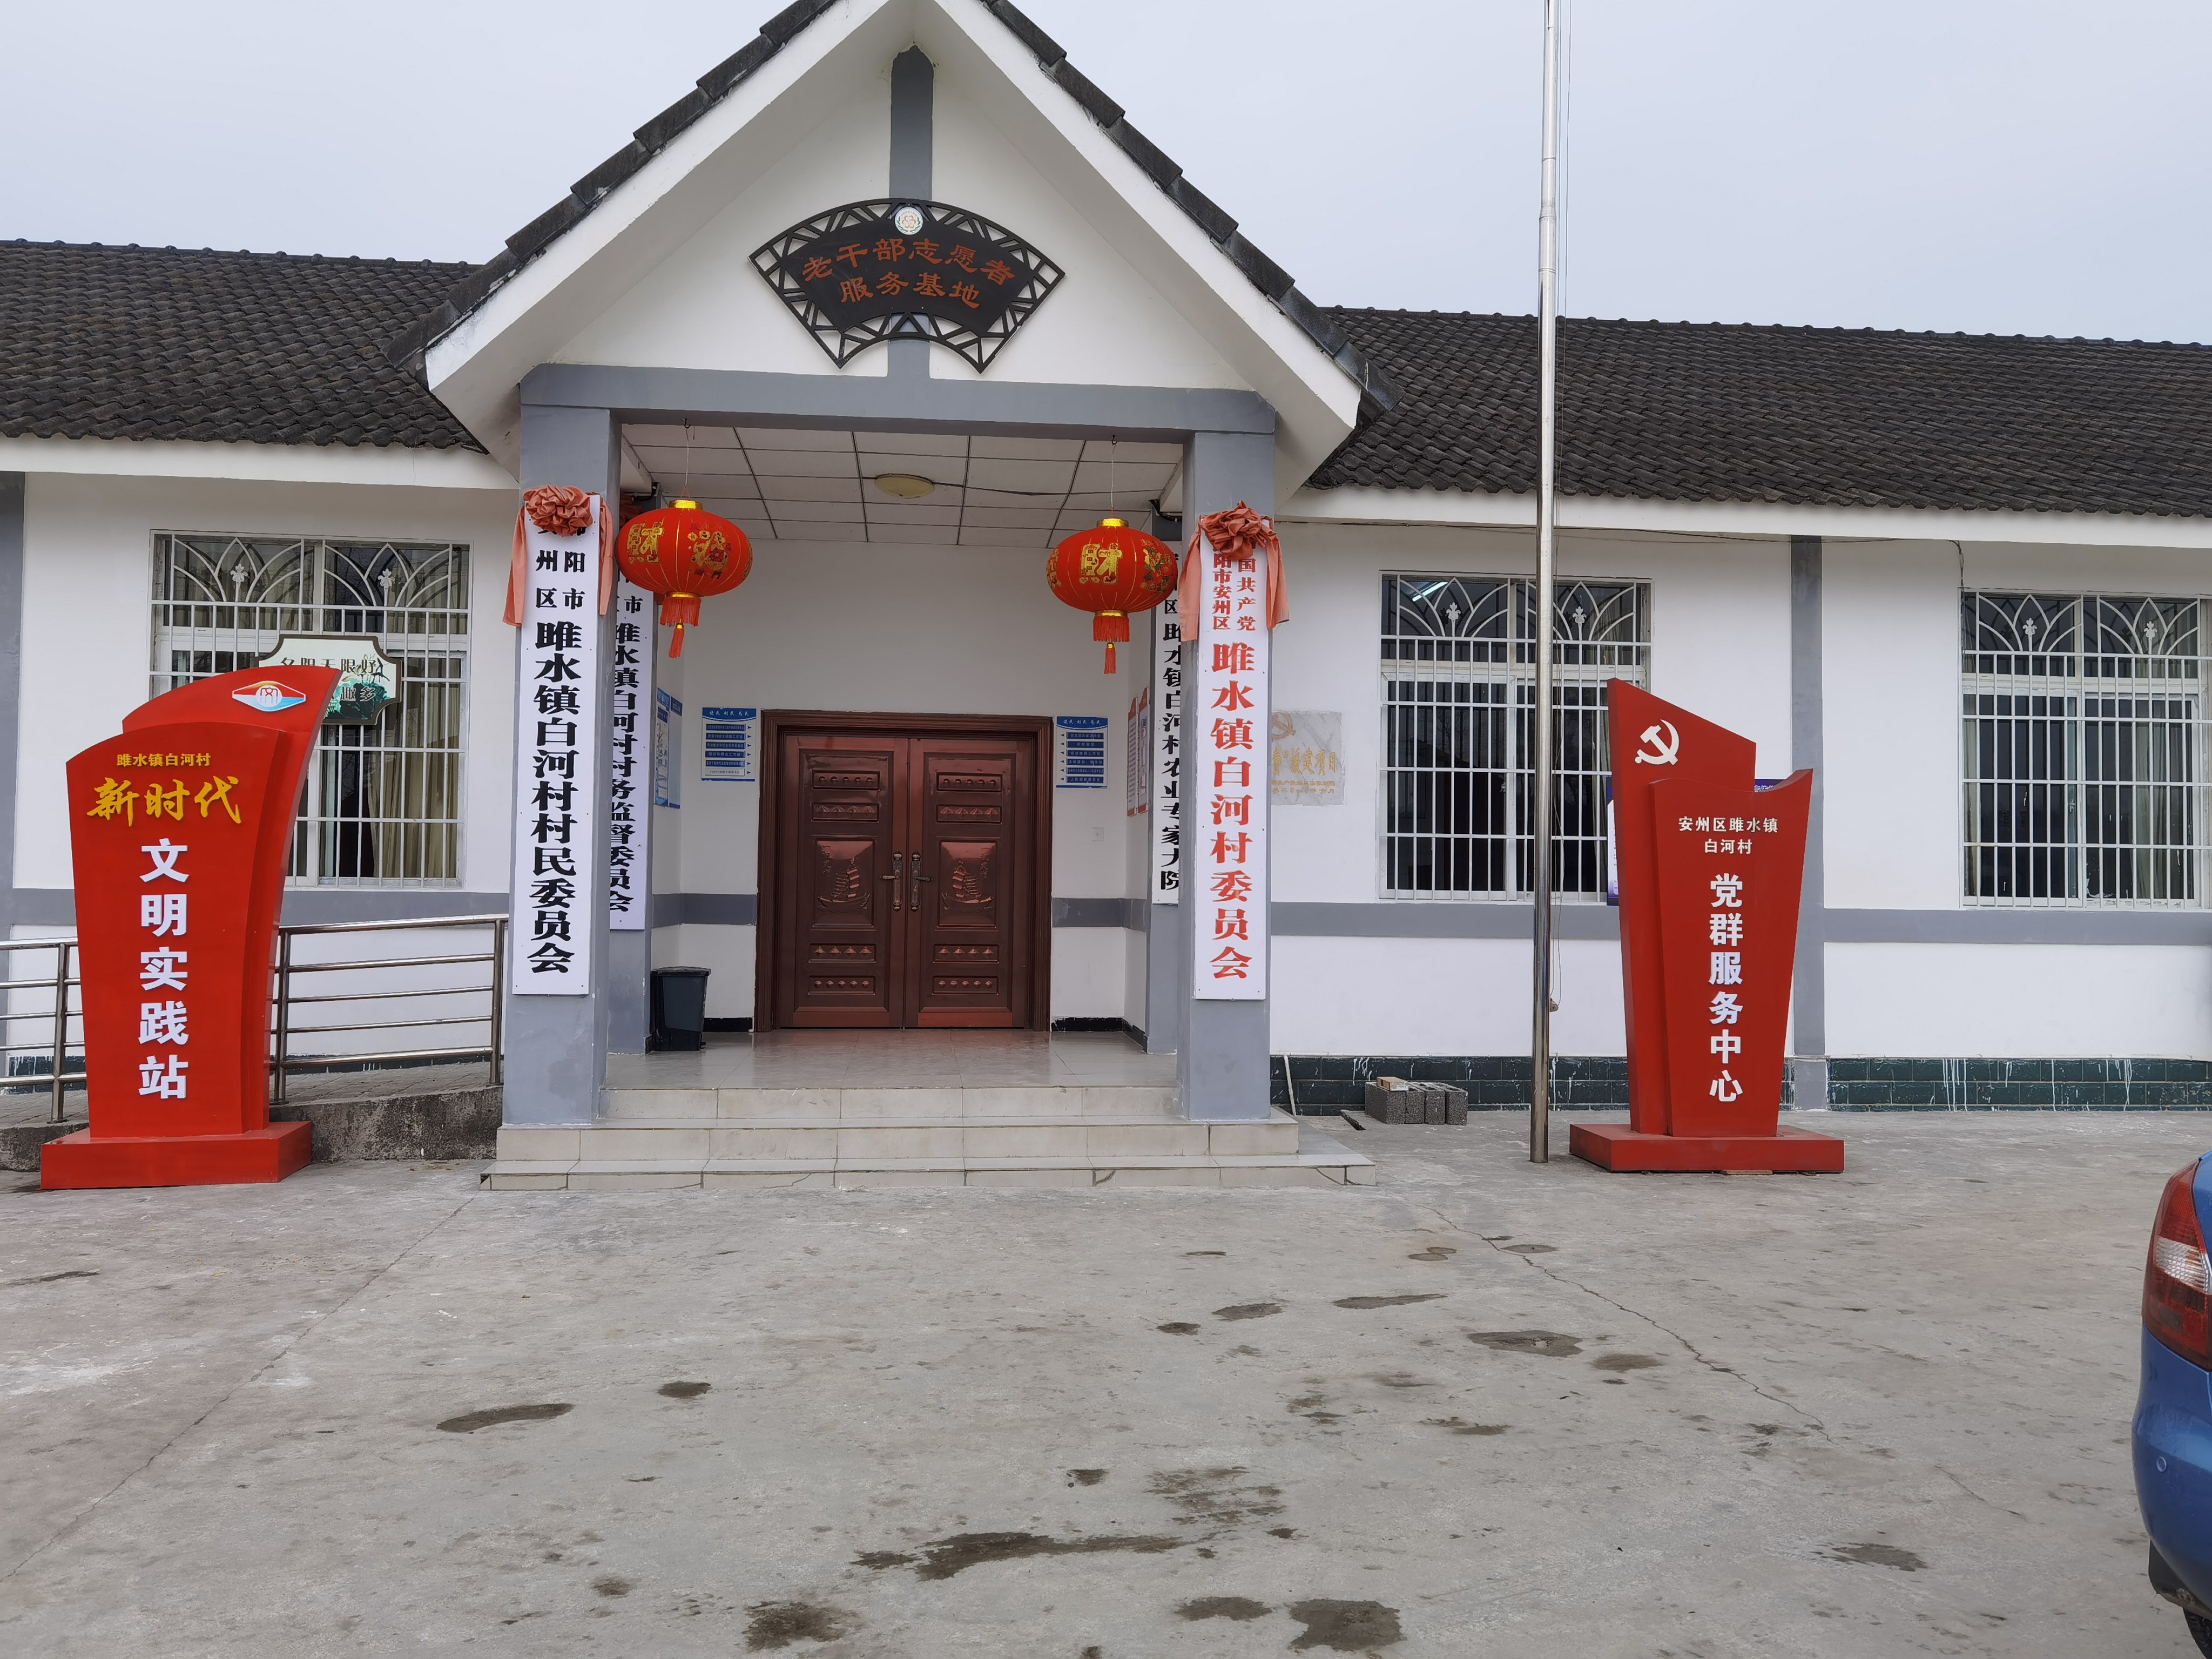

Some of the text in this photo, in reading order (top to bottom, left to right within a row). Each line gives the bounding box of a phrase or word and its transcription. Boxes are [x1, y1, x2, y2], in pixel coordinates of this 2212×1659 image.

[802, 238, 1015, 285] 老干部志愿者
[841, 272, 980, 308] 服务基地
[1237, 558, 1256, 631] 国共产党
[333, 686, 376, 702] 趣多
[116, 753, 212, 767] 雎水镇白河村
[86, 775, 241, 827] 新时代
[527, 621, 582, 973] 雎水镇白河村村民委员会
[1210, 642, 1255, 979] 雎水镇白河村委员会
[1678, 816, 1778, 833] 安州区雎水镇
[1704, 838, 1752, 854] 白河村
[138, 838, 189, 1099] 文明实践站
[1708, 873, 1744, 1102] 党群服务中心
